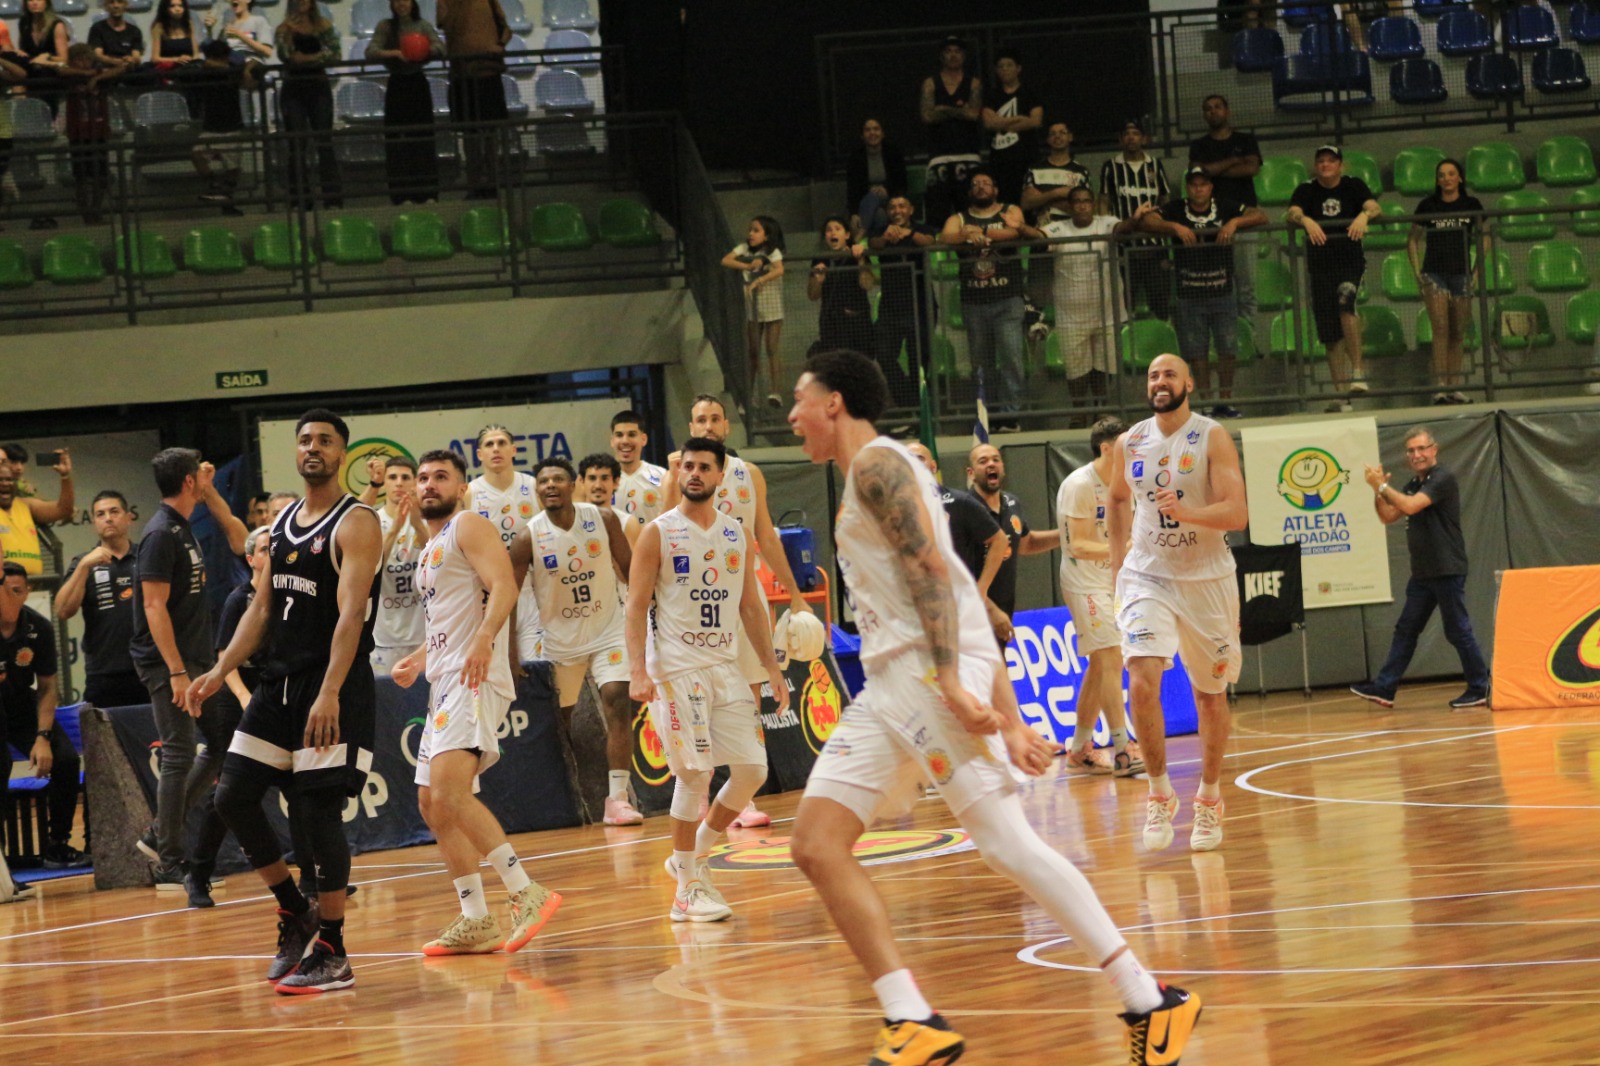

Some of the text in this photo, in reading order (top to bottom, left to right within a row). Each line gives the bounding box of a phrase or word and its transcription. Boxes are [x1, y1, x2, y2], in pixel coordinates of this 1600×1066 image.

[222, 372, 262, 388] SAÍDA
[448, 432, 573, 469] ATETA
[1147, 489, 1184, 502] CP
[1283, 512, 1347, 532] ATLETA
[1149, 531, 1197, 548] SCAR
[1283, 529, 1350, 546] CIDADÃO
[272, 574, 317, 597] RINTHIANS
[395, 576, 413, 594] 21
[561, 570, 595, 585] COOP
[1244, 571, 1283, 603] KIEF
[571, 585, 591, 604] 19
[690, 589, 729, 601] COOP
[283, 596, 294, 621] 7
[701, 603, 720, 628] 91
[761, 709, 800, 730] PAULISTA
